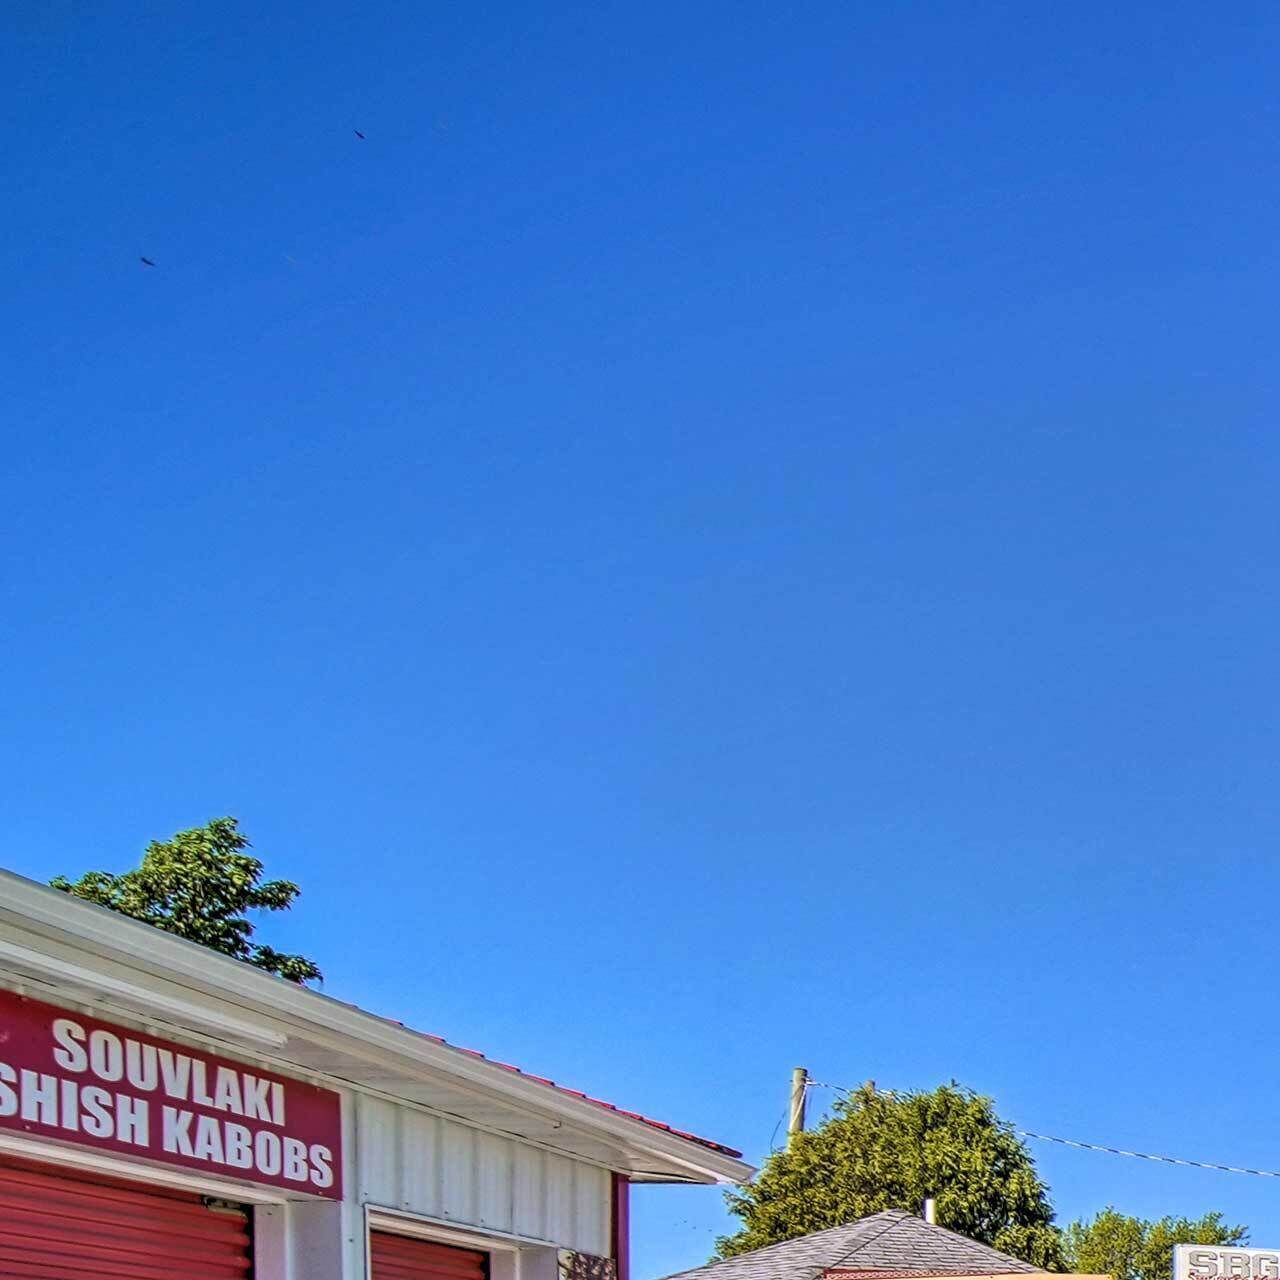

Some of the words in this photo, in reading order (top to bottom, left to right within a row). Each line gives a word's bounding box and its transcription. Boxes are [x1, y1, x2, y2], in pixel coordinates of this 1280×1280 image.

[52, 1018, 286, 1127] SOUVLAKI
[162, 1104, 335, 1188] KABOBS
[1188, 1250, 1279, 1278] SBG
